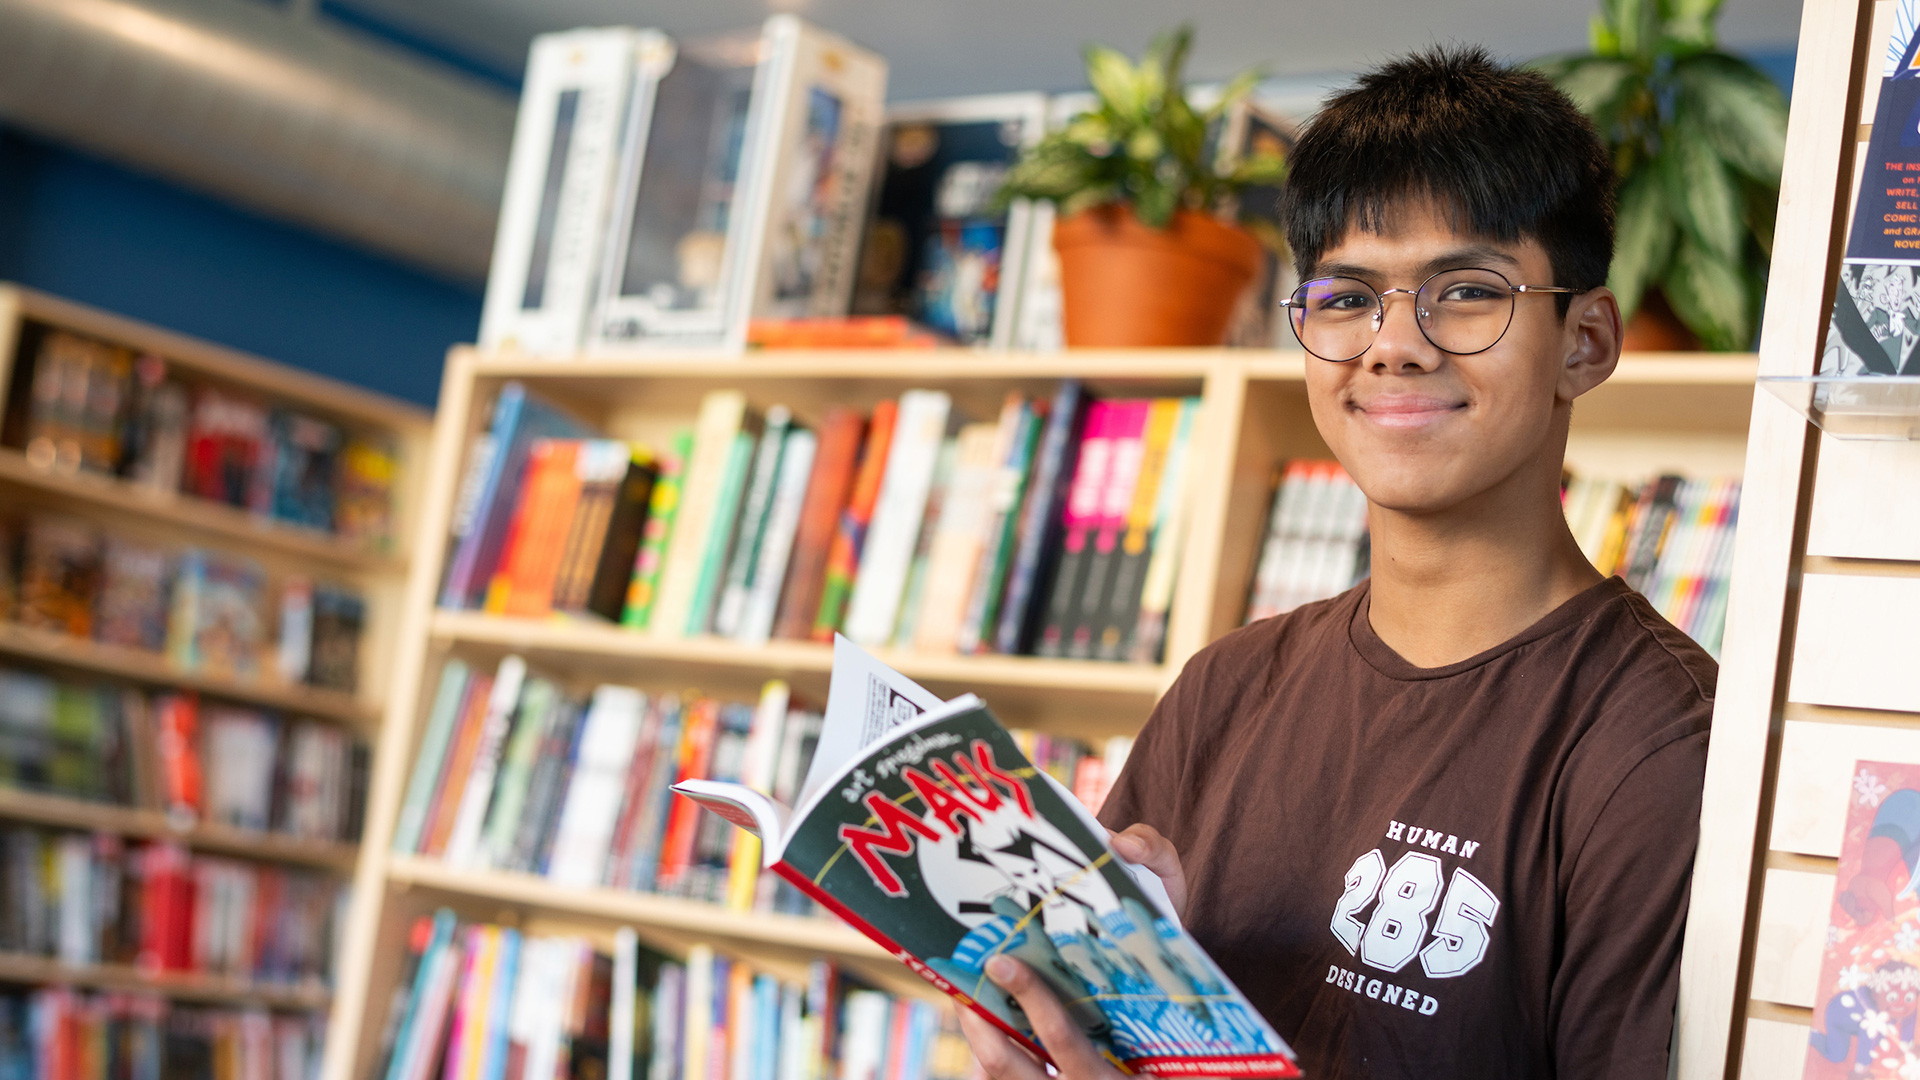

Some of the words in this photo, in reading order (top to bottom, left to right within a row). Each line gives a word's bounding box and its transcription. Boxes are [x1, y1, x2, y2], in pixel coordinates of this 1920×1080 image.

[1885, 162, 1903, 171] THE
[1886, 188, 1919, 198] WRITE,
[1895, 201, 1918, 210] SELL
[1883, 213, 1917, 222] COMIC
[1883, 227, 1902, 235] and
[838, 739, 1036, 898] MAUS
[1386, 820, 1480, 859] HUMAN
[1330, 848, 1500, 978] 285
[1325, 964, 1439, 1016] DESIGNED
